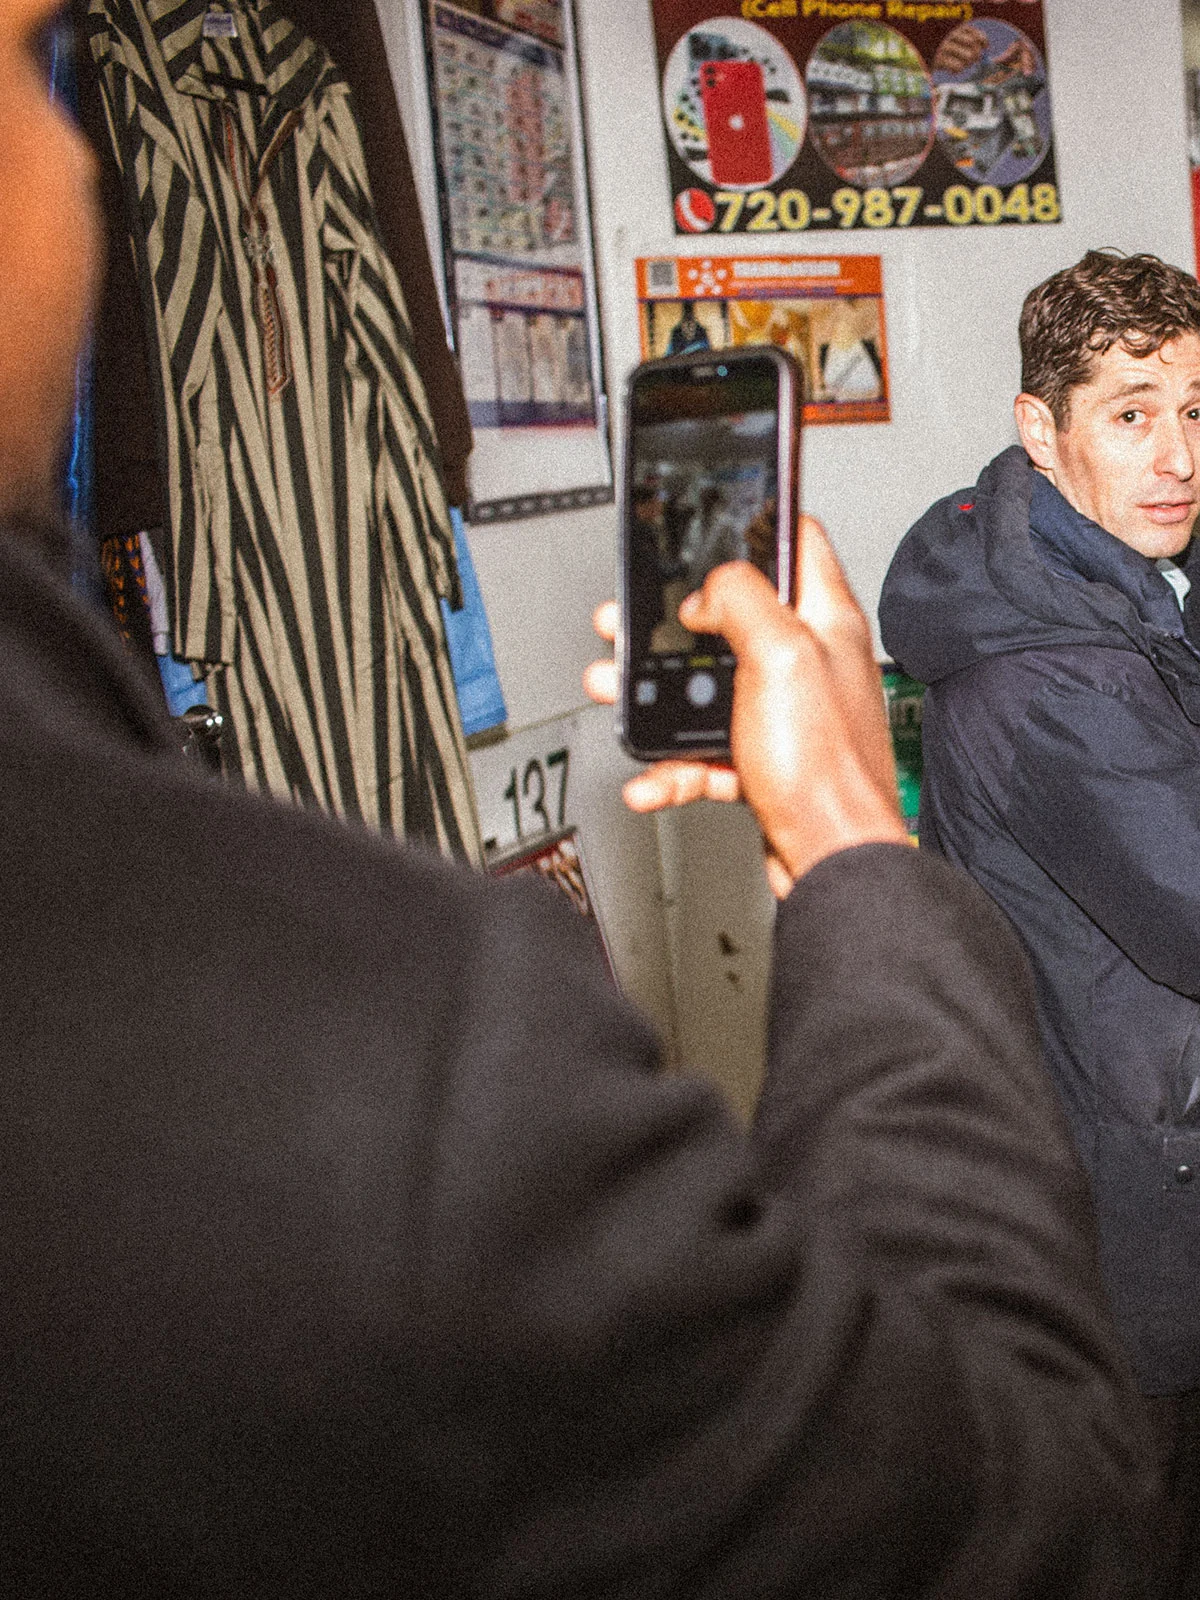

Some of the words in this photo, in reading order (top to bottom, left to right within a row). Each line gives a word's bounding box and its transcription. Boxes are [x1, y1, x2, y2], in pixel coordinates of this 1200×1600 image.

[742, 0, 797, 19] (Cell
[802, 0, 881, 19] Phone
[887, 0, 973, 22] Repair)
[715, 184, 1060, 232] 720-987-0048
